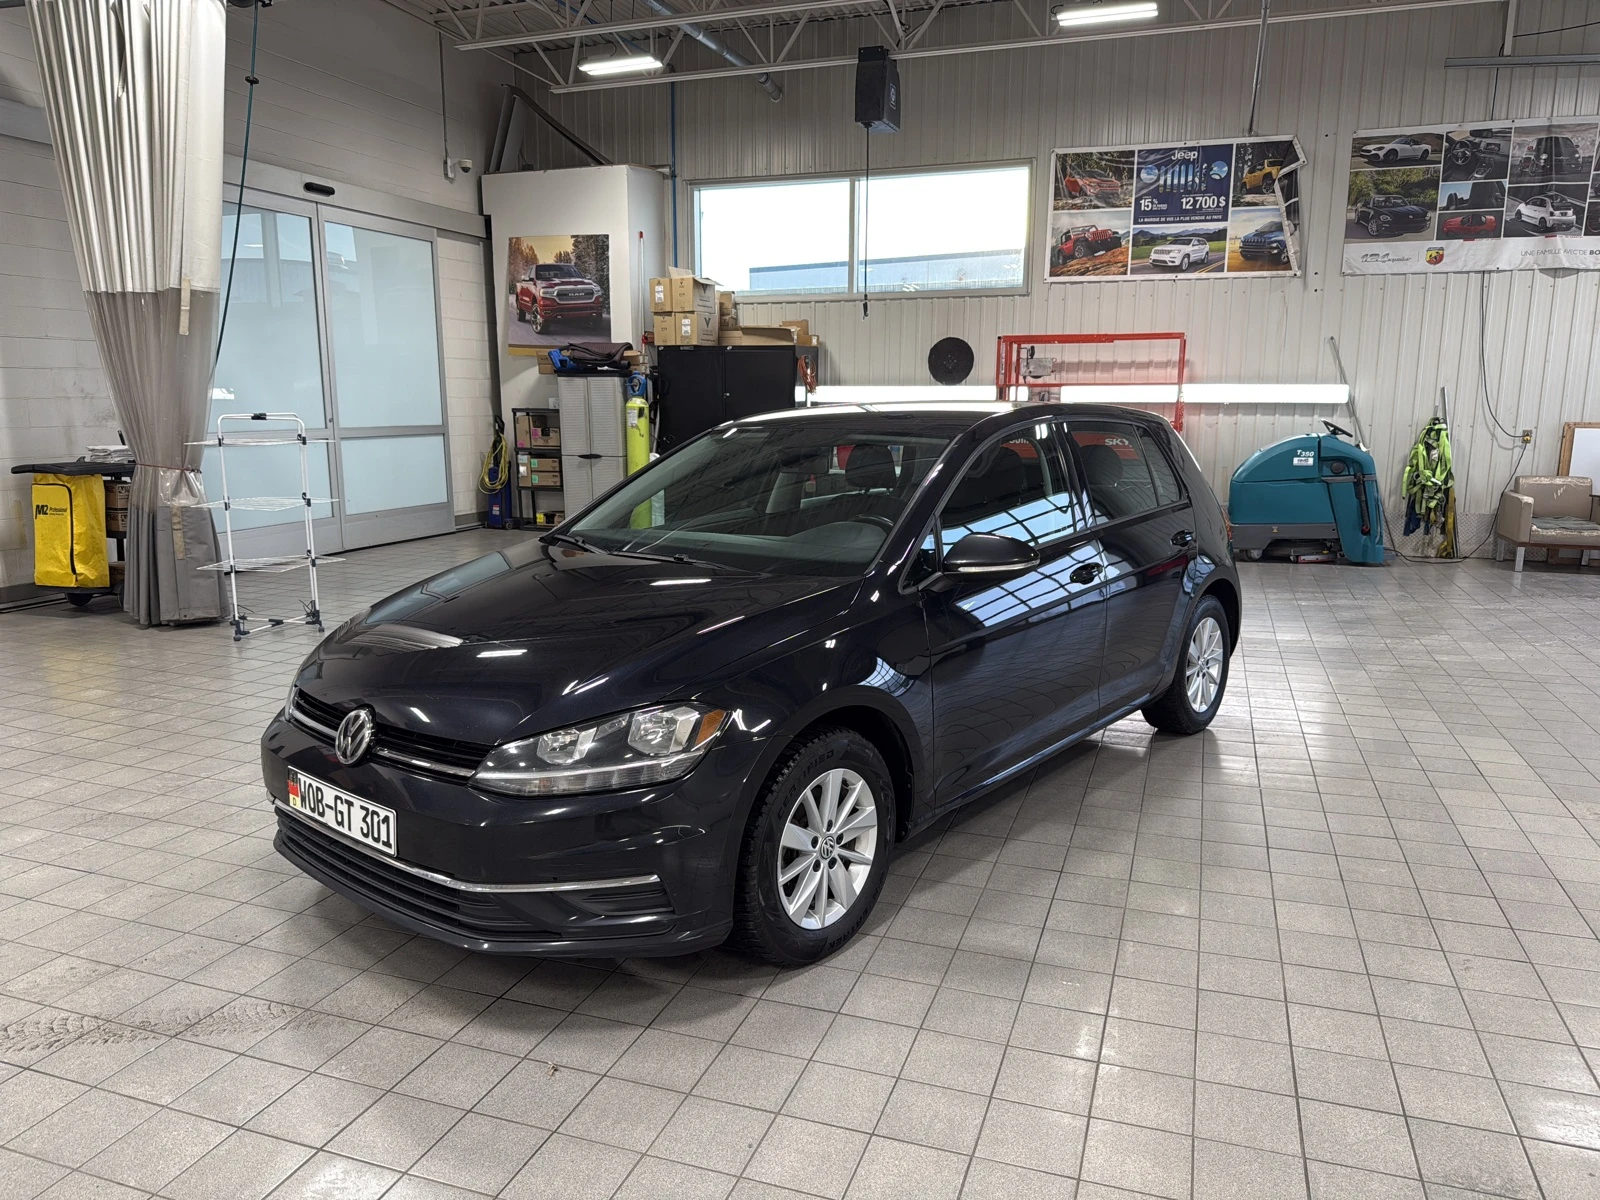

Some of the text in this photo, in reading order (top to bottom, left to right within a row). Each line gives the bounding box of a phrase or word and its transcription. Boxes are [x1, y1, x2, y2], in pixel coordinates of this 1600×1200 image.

[1171, 150, 1198, 161] Jeep
[1140, 198, 1152, 211] 15
[1181, 196, 1226, 209] 12 700 $
[35, 504, 49, 519] M2
[778, 749, 834, 820] CERIFIED
[292, 797, 297, 806] D
[299, 778, 392, 849] WOB-GT 301
